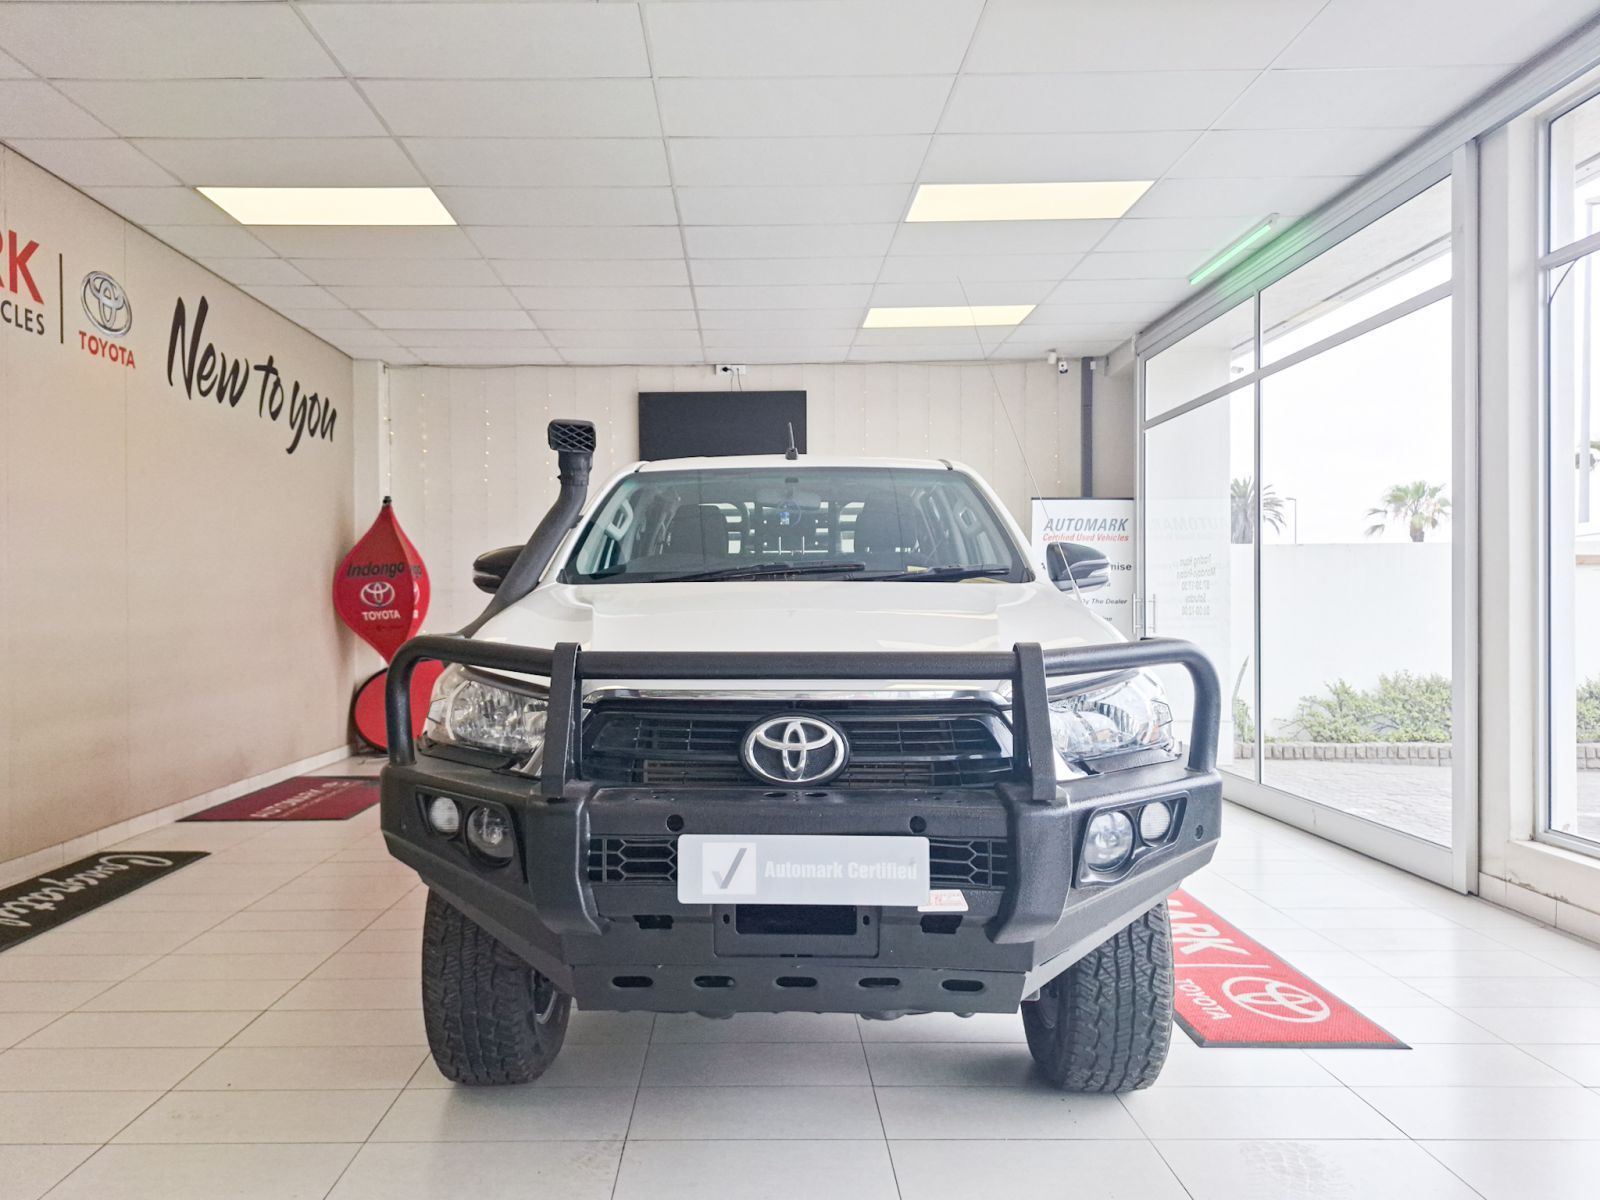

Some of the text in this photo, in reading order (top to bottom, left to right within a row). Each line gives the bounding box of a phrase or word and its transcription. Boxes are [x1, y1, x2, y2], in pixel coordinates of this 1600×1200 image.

[79, 330, 136, 369] TOYOTA
[167, 296, 337, 454] New to you
[1043, 518, 1129, 532] AUTOMARK
[1042, 533, 1129, 542] Certified Used Vehicles
[361, 609, 401, 621] TOYOTA
[764, 861, 918, 880] Automark Certified
[1174, 978, 1233, 1020] TOYOTA
